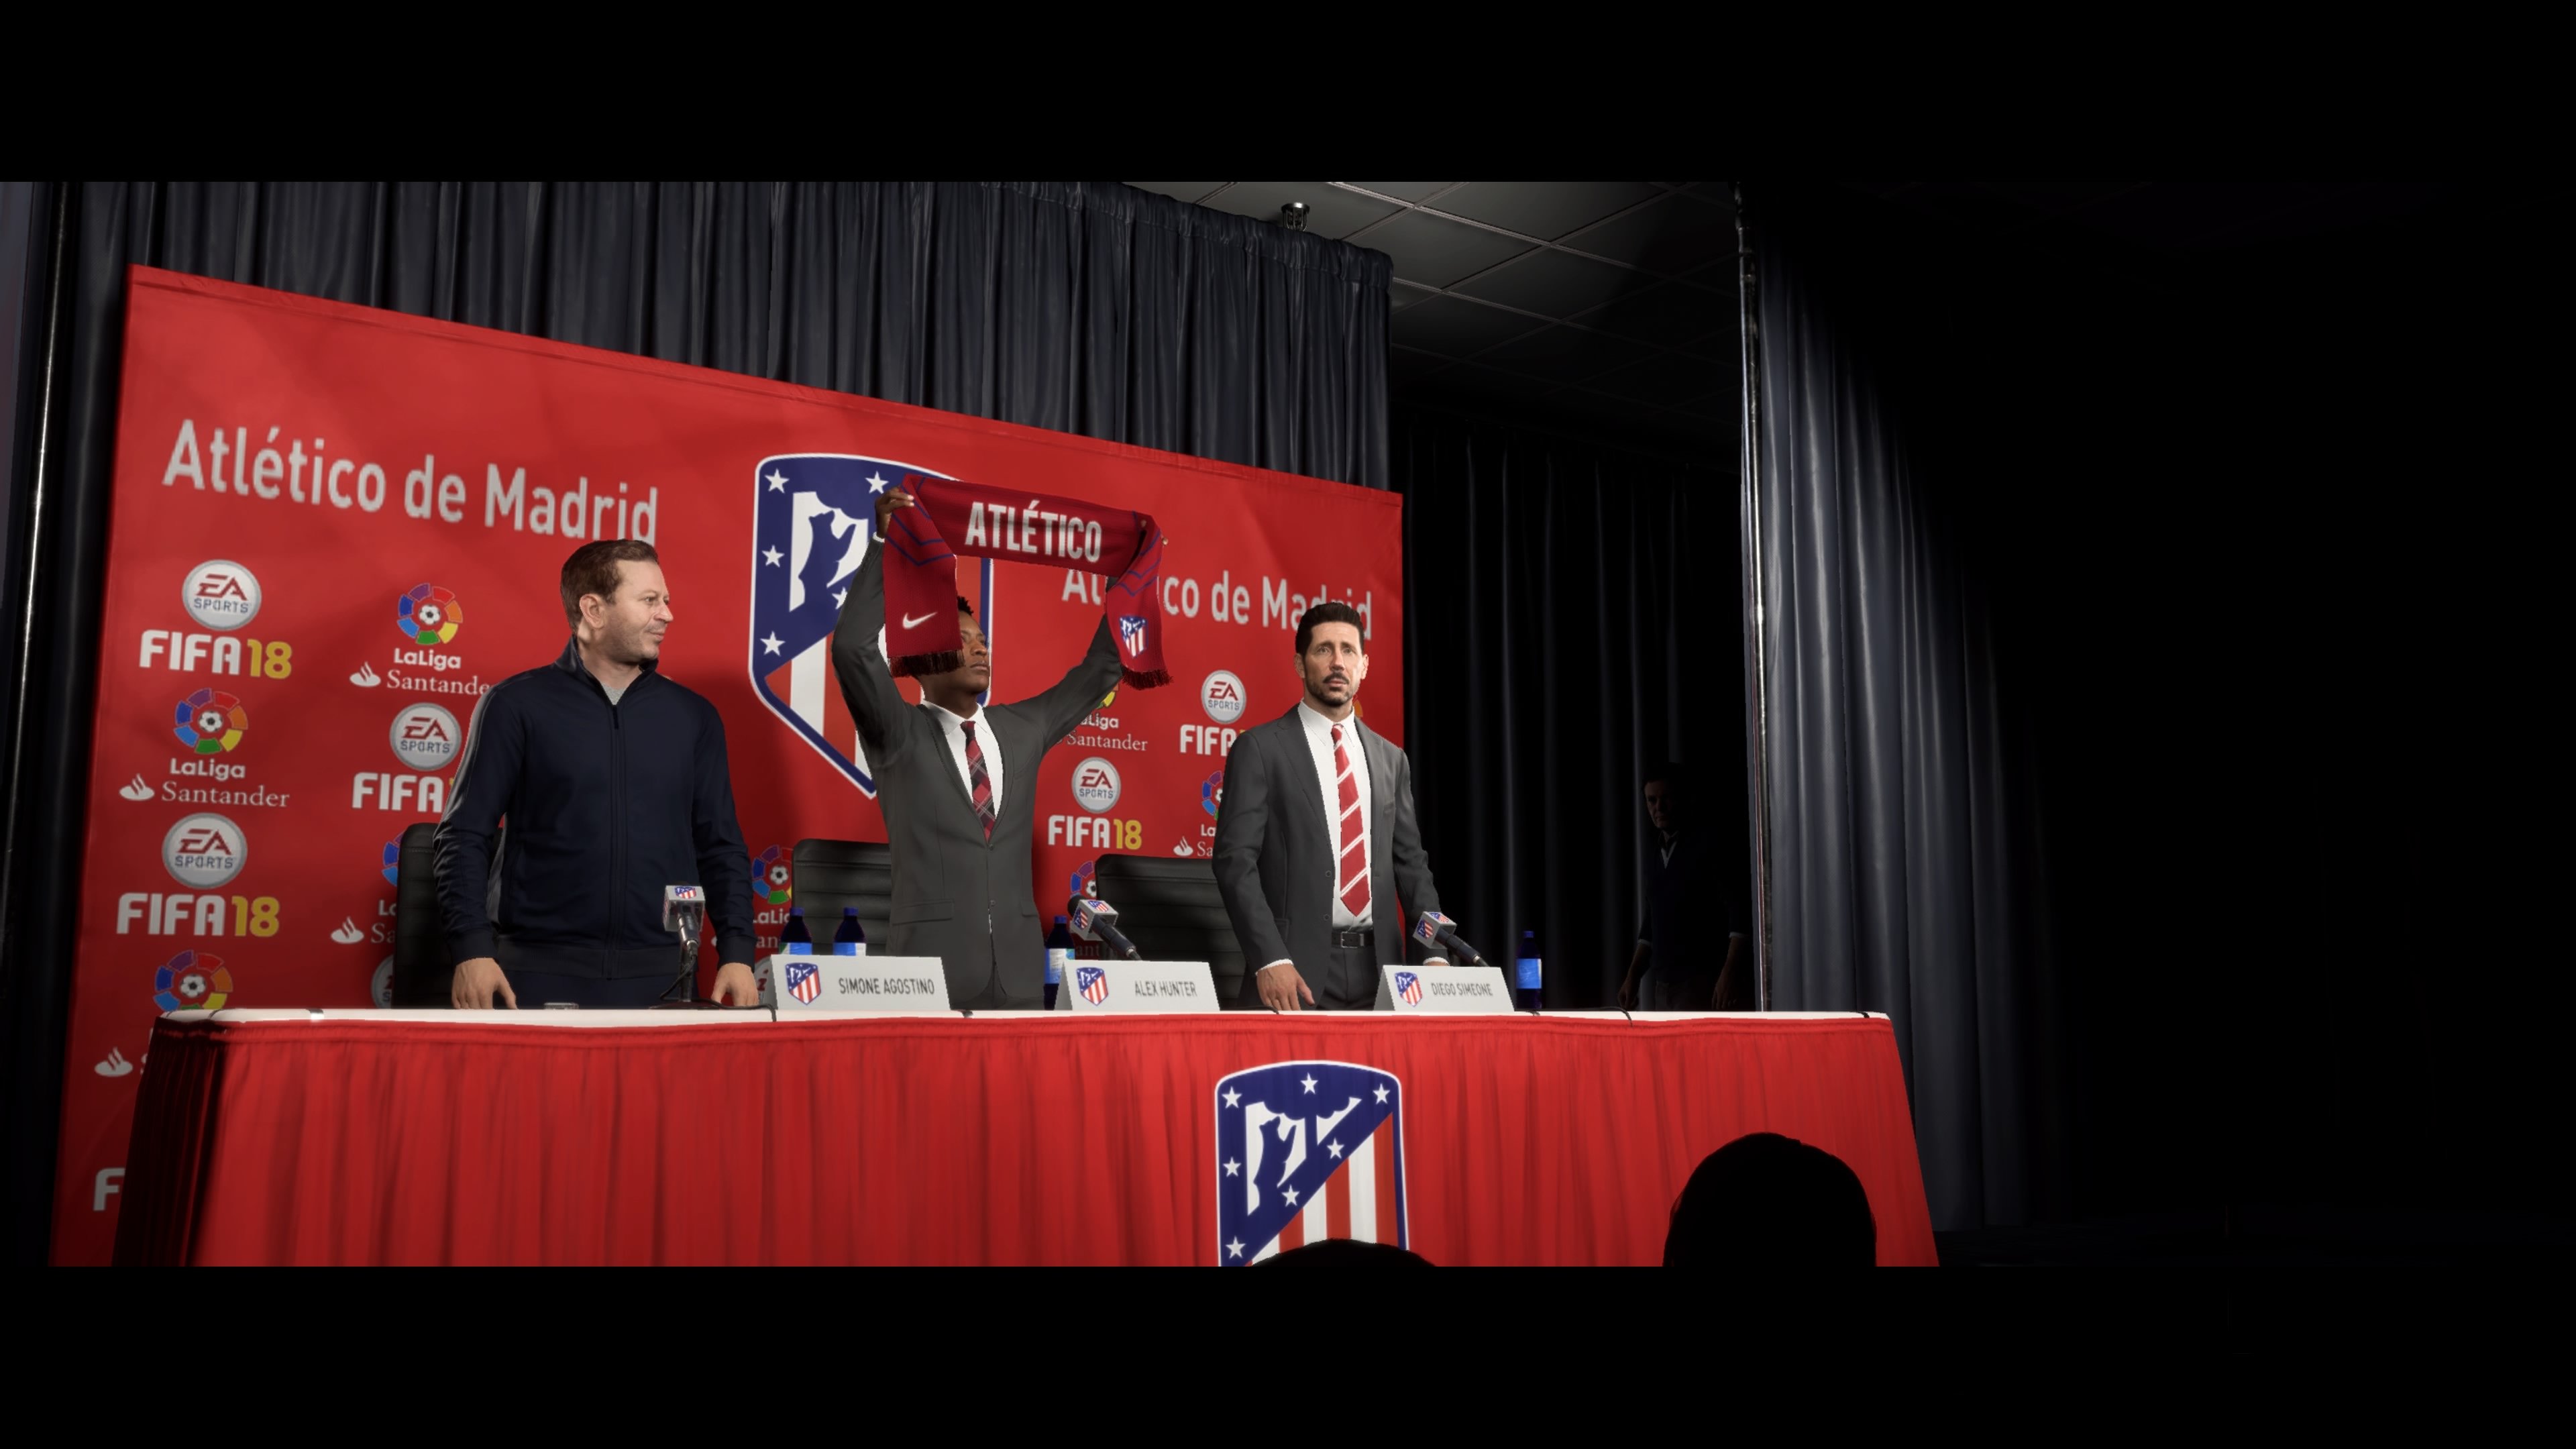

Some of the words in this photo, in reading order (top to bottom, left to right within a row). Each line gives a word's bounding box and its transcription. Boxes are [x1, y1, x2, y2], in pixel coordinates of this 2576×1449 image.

[163, 420, 386, 512] Atlético
[404, 454, 466, 523] de
[485, 464, 657, 547] Madrid
[965, 499, 1102, 564] ATLÉTICO
[196, 573, 248, 601] EA
[1212, 570, 1250, 625] de
[193, 597, 249, 614] SPORTS
[139, 629, 241, 674] FIFA
[247, 639, 292, 679] 18
[393, 648, 462, 671] LaLiga
[386, 669, 490, 696] Santande
[1208, 681, 1239, 701] EA
[1208, 699, 1240, 711] SPORTS
[402, 716, 449, 741] EA
[1067, 729, 1148, 751] Santander
[400, 739, 451, 753] SPORTS
[170, 757, 246, 780] LaLiga
[1080, 768, 1113, 789] EA
[161, 780, 290, 808] Santander
[352, 772, 444, 813] FIFA
[1078, 788, 1114, 799] SPORTS
[178, 828, 231, 855] EA
[1048, 814, 1110, 849] FIFA
[1114, 818, 1142, 851] 18
[174, 855, 234, 870] SPORTS
[117, 893, 225, 936] FIFA
[231, 896, 280, 937] 18
[839, 977, 881, 994] SIMONE
[884, 978, 934, 996] AGOSTINO
[1134, 981, 1159, 997] ALEX
[1160, 981, 1197, 998] HUNTER
[1430, 982, 1456, 996] DIEGO
[1457, 982, 1493, 997] SIMEONE
